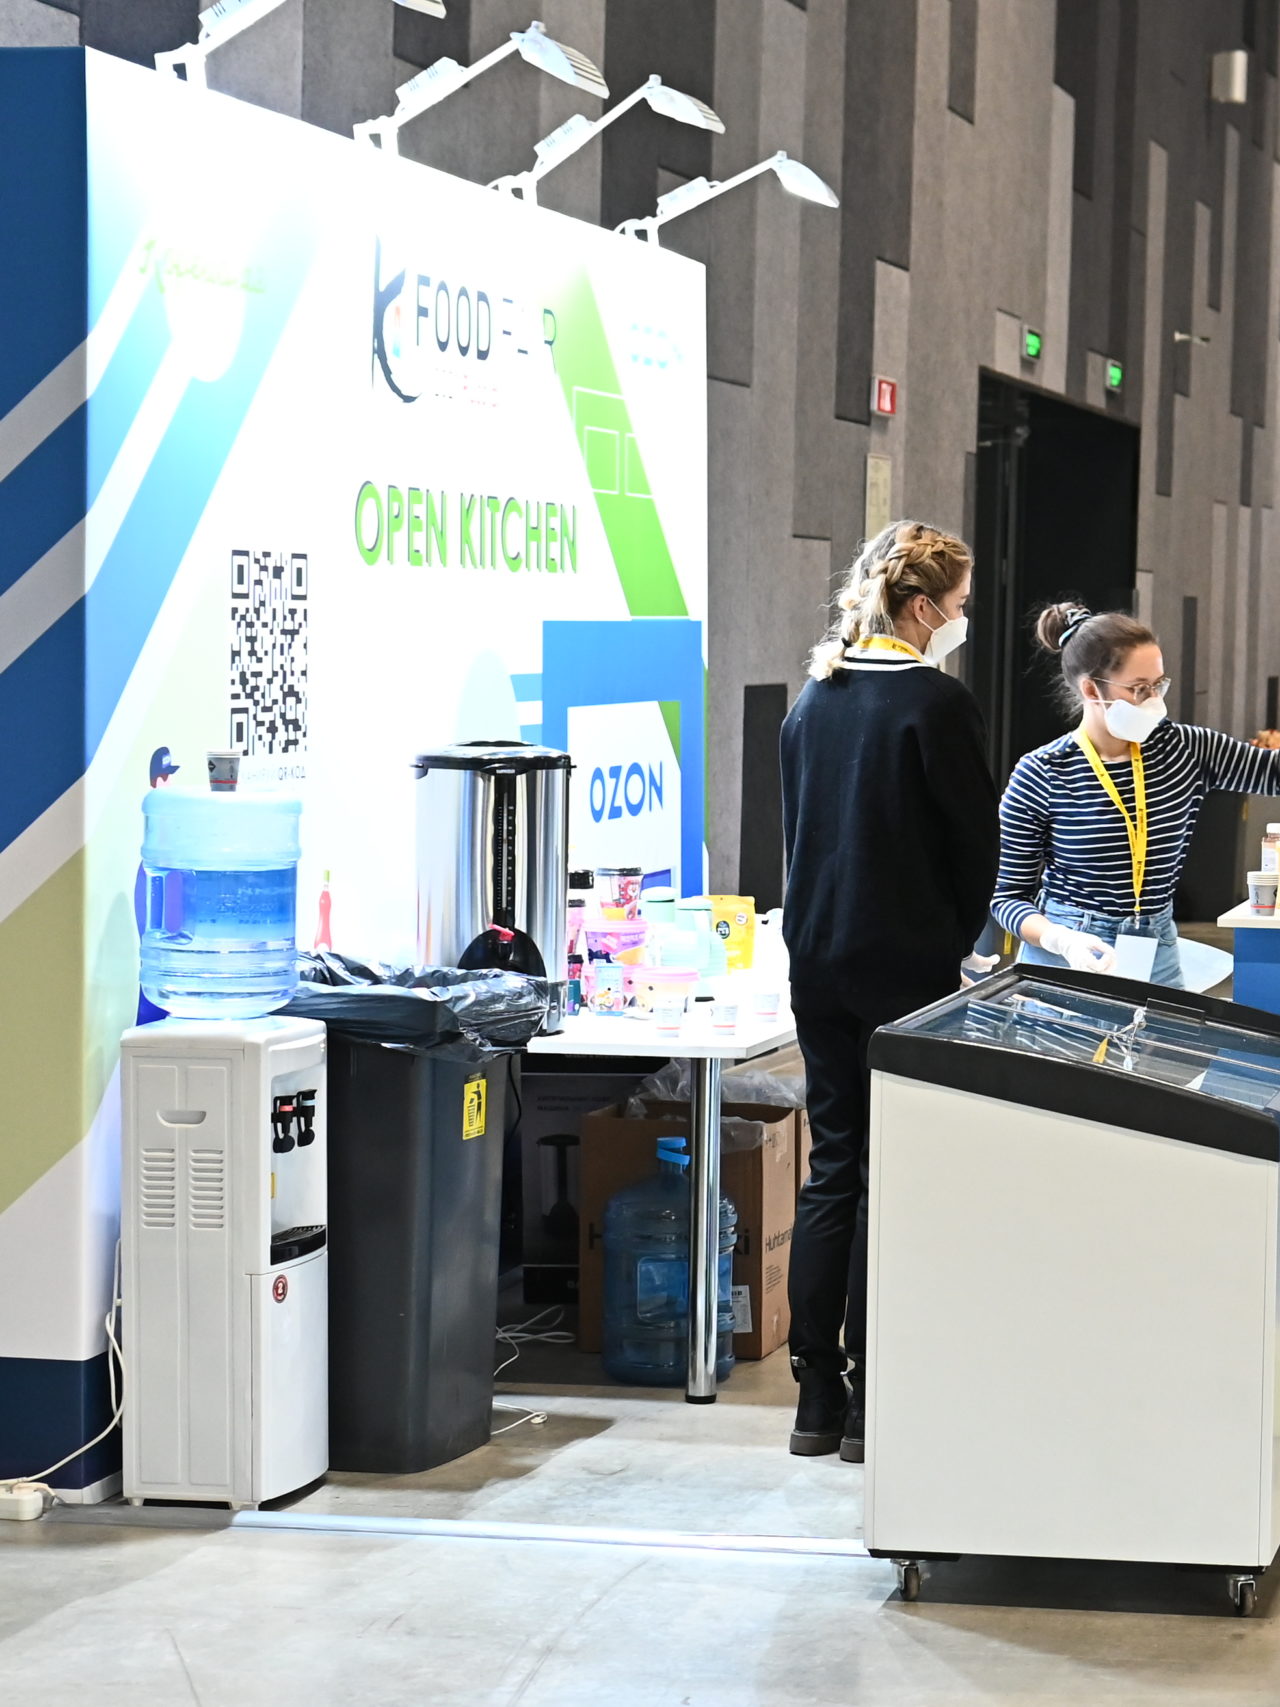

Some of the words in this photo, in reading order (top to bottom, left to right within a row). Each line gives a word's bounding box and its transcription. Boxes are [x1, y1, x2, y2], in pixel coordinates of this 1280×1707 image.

[416, 273, 491, 361] FOOD
[354, 480, 447, 567] OPEN
[459, 492, 577, 573] KITCHEN
[590, 759, 663, 823] OZON
[765, 1228, 793, 1254] Huhtama
